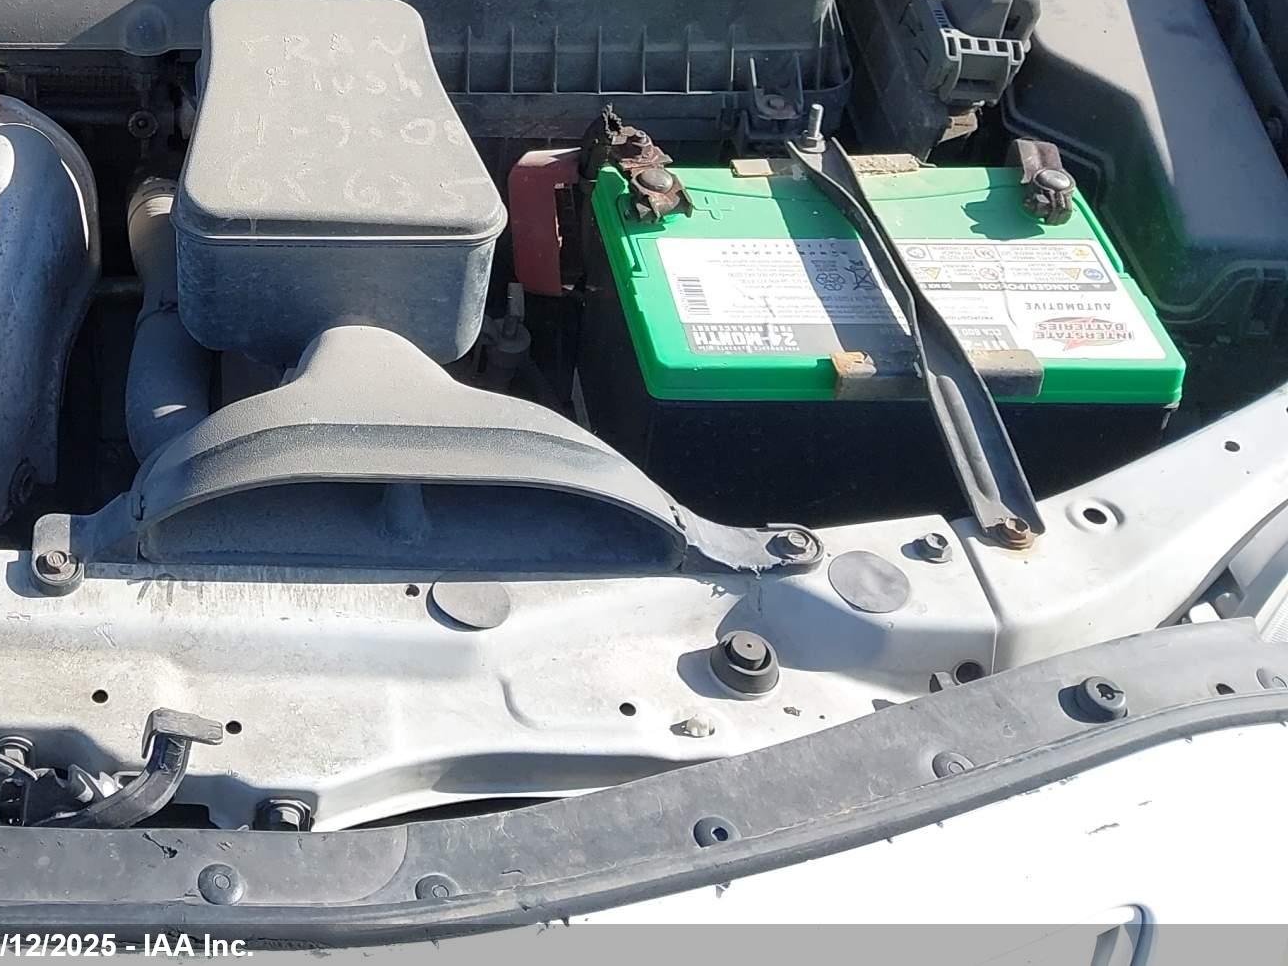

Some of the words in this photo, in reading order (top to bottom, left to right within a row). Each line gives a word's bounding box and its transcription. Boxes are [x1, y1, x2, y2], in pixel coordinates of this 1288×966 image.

[1025, 302, 1112, 311] AUTOMOTIVE
[1038, 322, 1125, 331] BATTERIES
[692, 331, 798, 346] 24-MONTH
[1035, 330, 1134, 341] INTERSTATE
